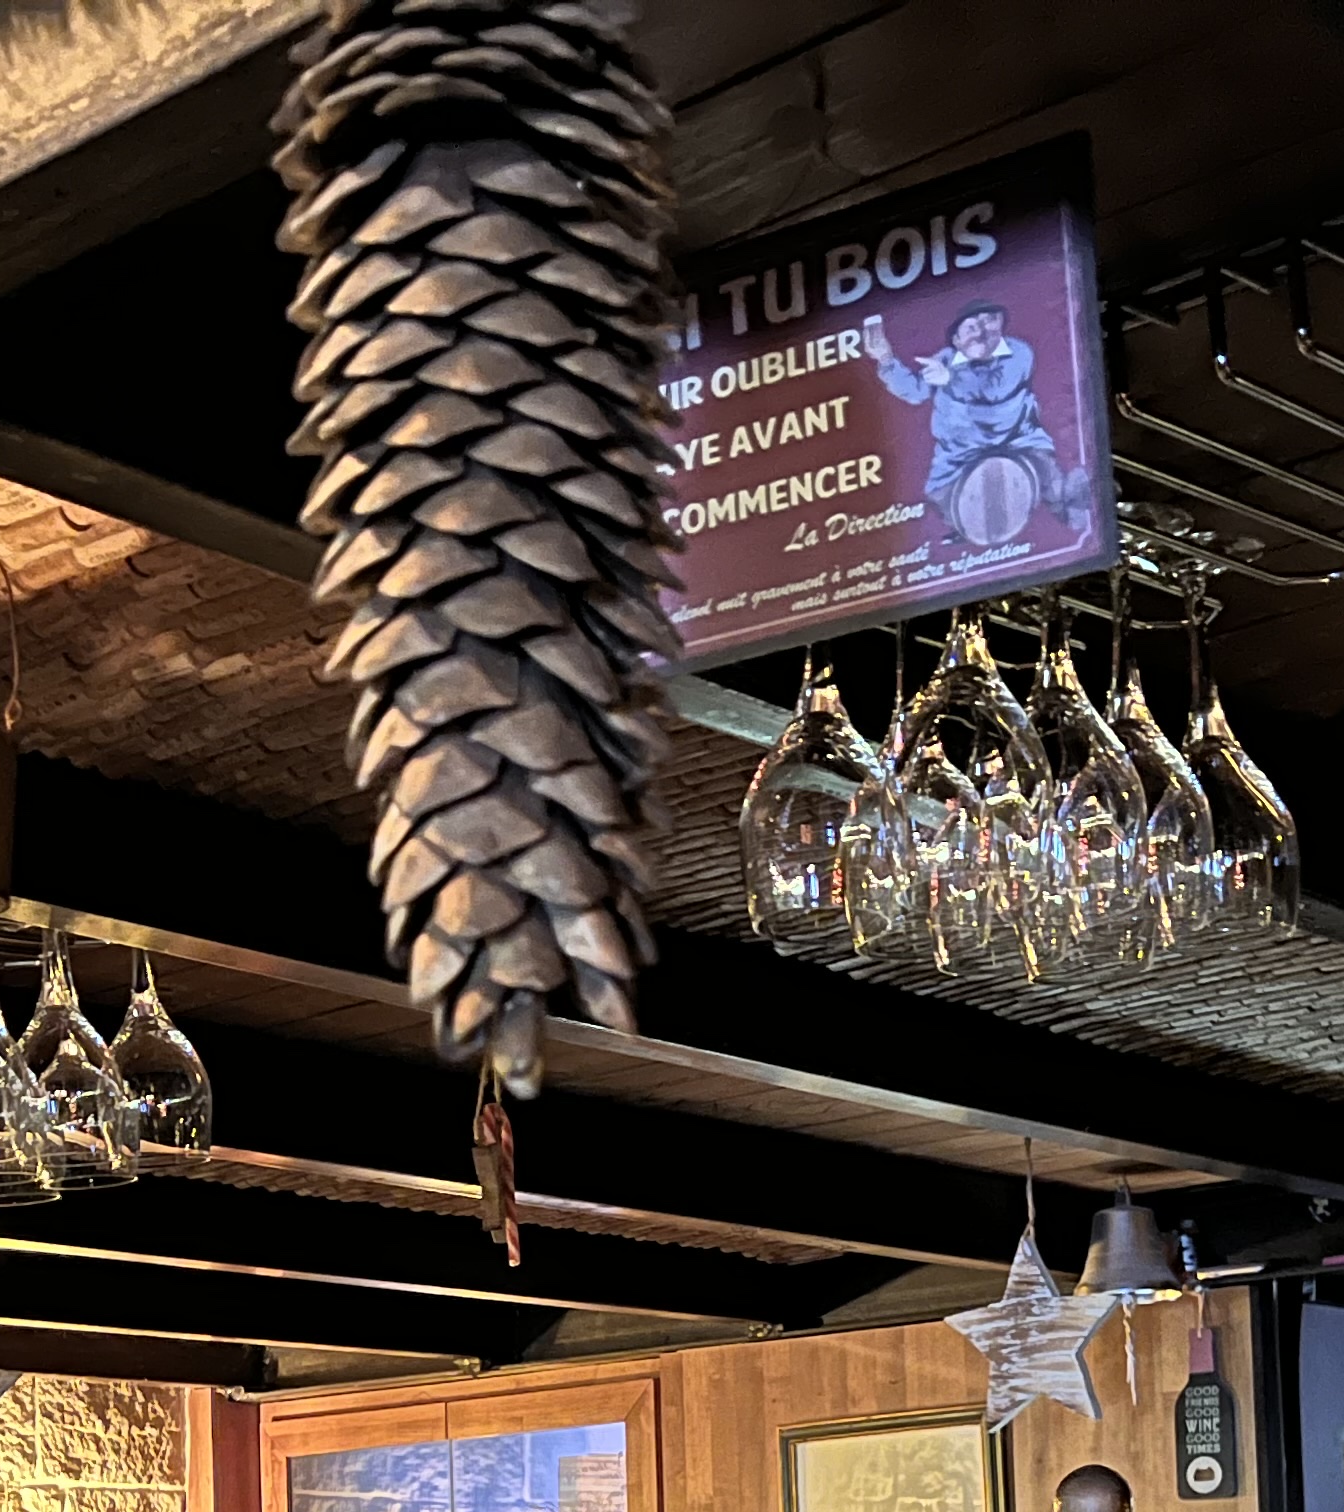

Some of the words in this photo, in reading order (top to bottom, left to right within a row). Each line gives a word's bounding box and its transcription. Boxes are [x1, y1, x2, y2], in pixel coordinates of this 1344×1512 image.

[719, 261, 807, 336] TU
[826, 202, 997, 307] BOIS
[711, 329, 862, 399] OUBLIER
[729, 396, 850, 459] AVANT
[784, 521, 819, 552] La
[824, 502, 925, 542] Direction
[716, 591, 748, 612] nuit
[751, 571, 828, 609] gravement
[888, 541, 931, 568] santé
[791, 592, 829, 612] mais
[1185, 1385, 1219, 1397] GOOD
[1185, 1407, 1220, 1418] GOOD
[1185, 1417, 1220, 1432] WINE
[1186, 1432, 1220, 1443] GOOD
[1186, 1443, 1221, 1454] TIMES
